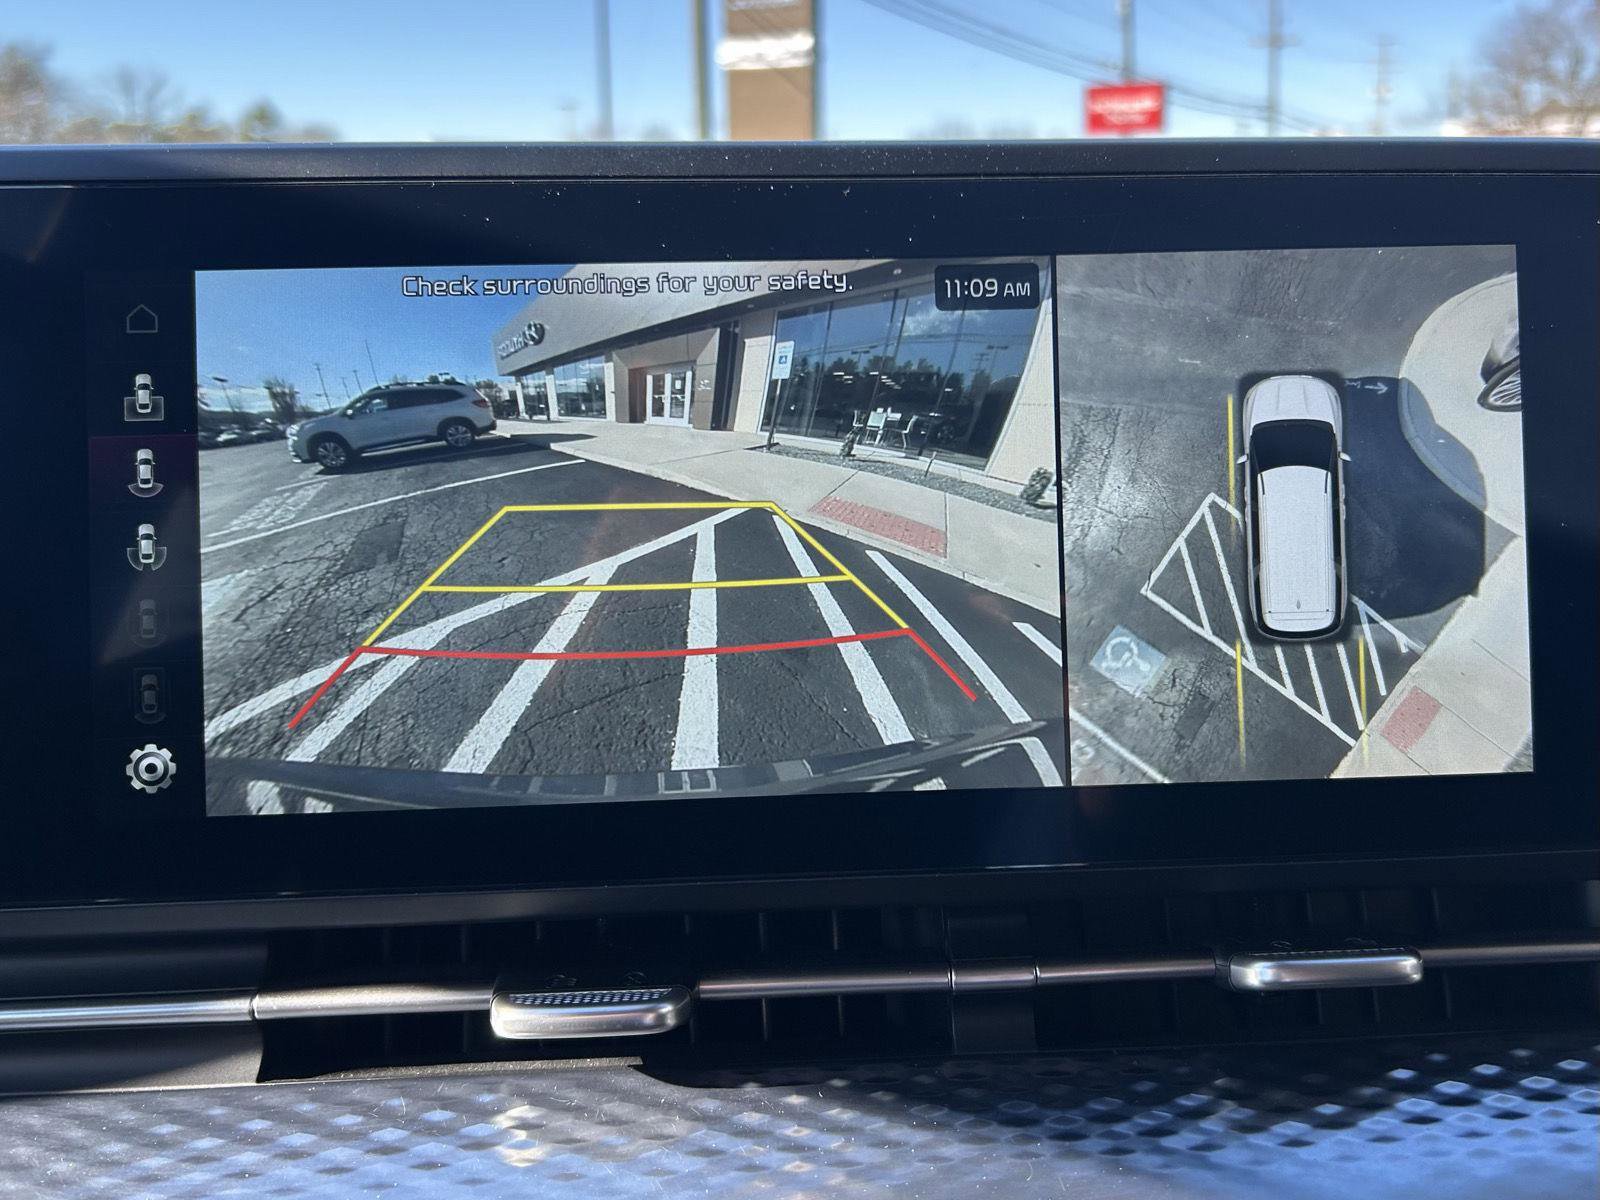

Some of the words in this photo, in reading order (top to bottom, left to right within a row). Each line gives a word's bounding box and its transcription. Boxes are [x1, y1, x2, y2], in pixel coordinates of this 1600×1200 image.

[402, 275, 478, 296] Check
[483, 273, 650, 297] surroundings
[657, 272, 697, 293] for
[703, 274, 761, 295] your
[768, 270, 854, 293] safety.
[945, 278, 998, 298] 11:09
[1003, 282, 1031, 297] AM
